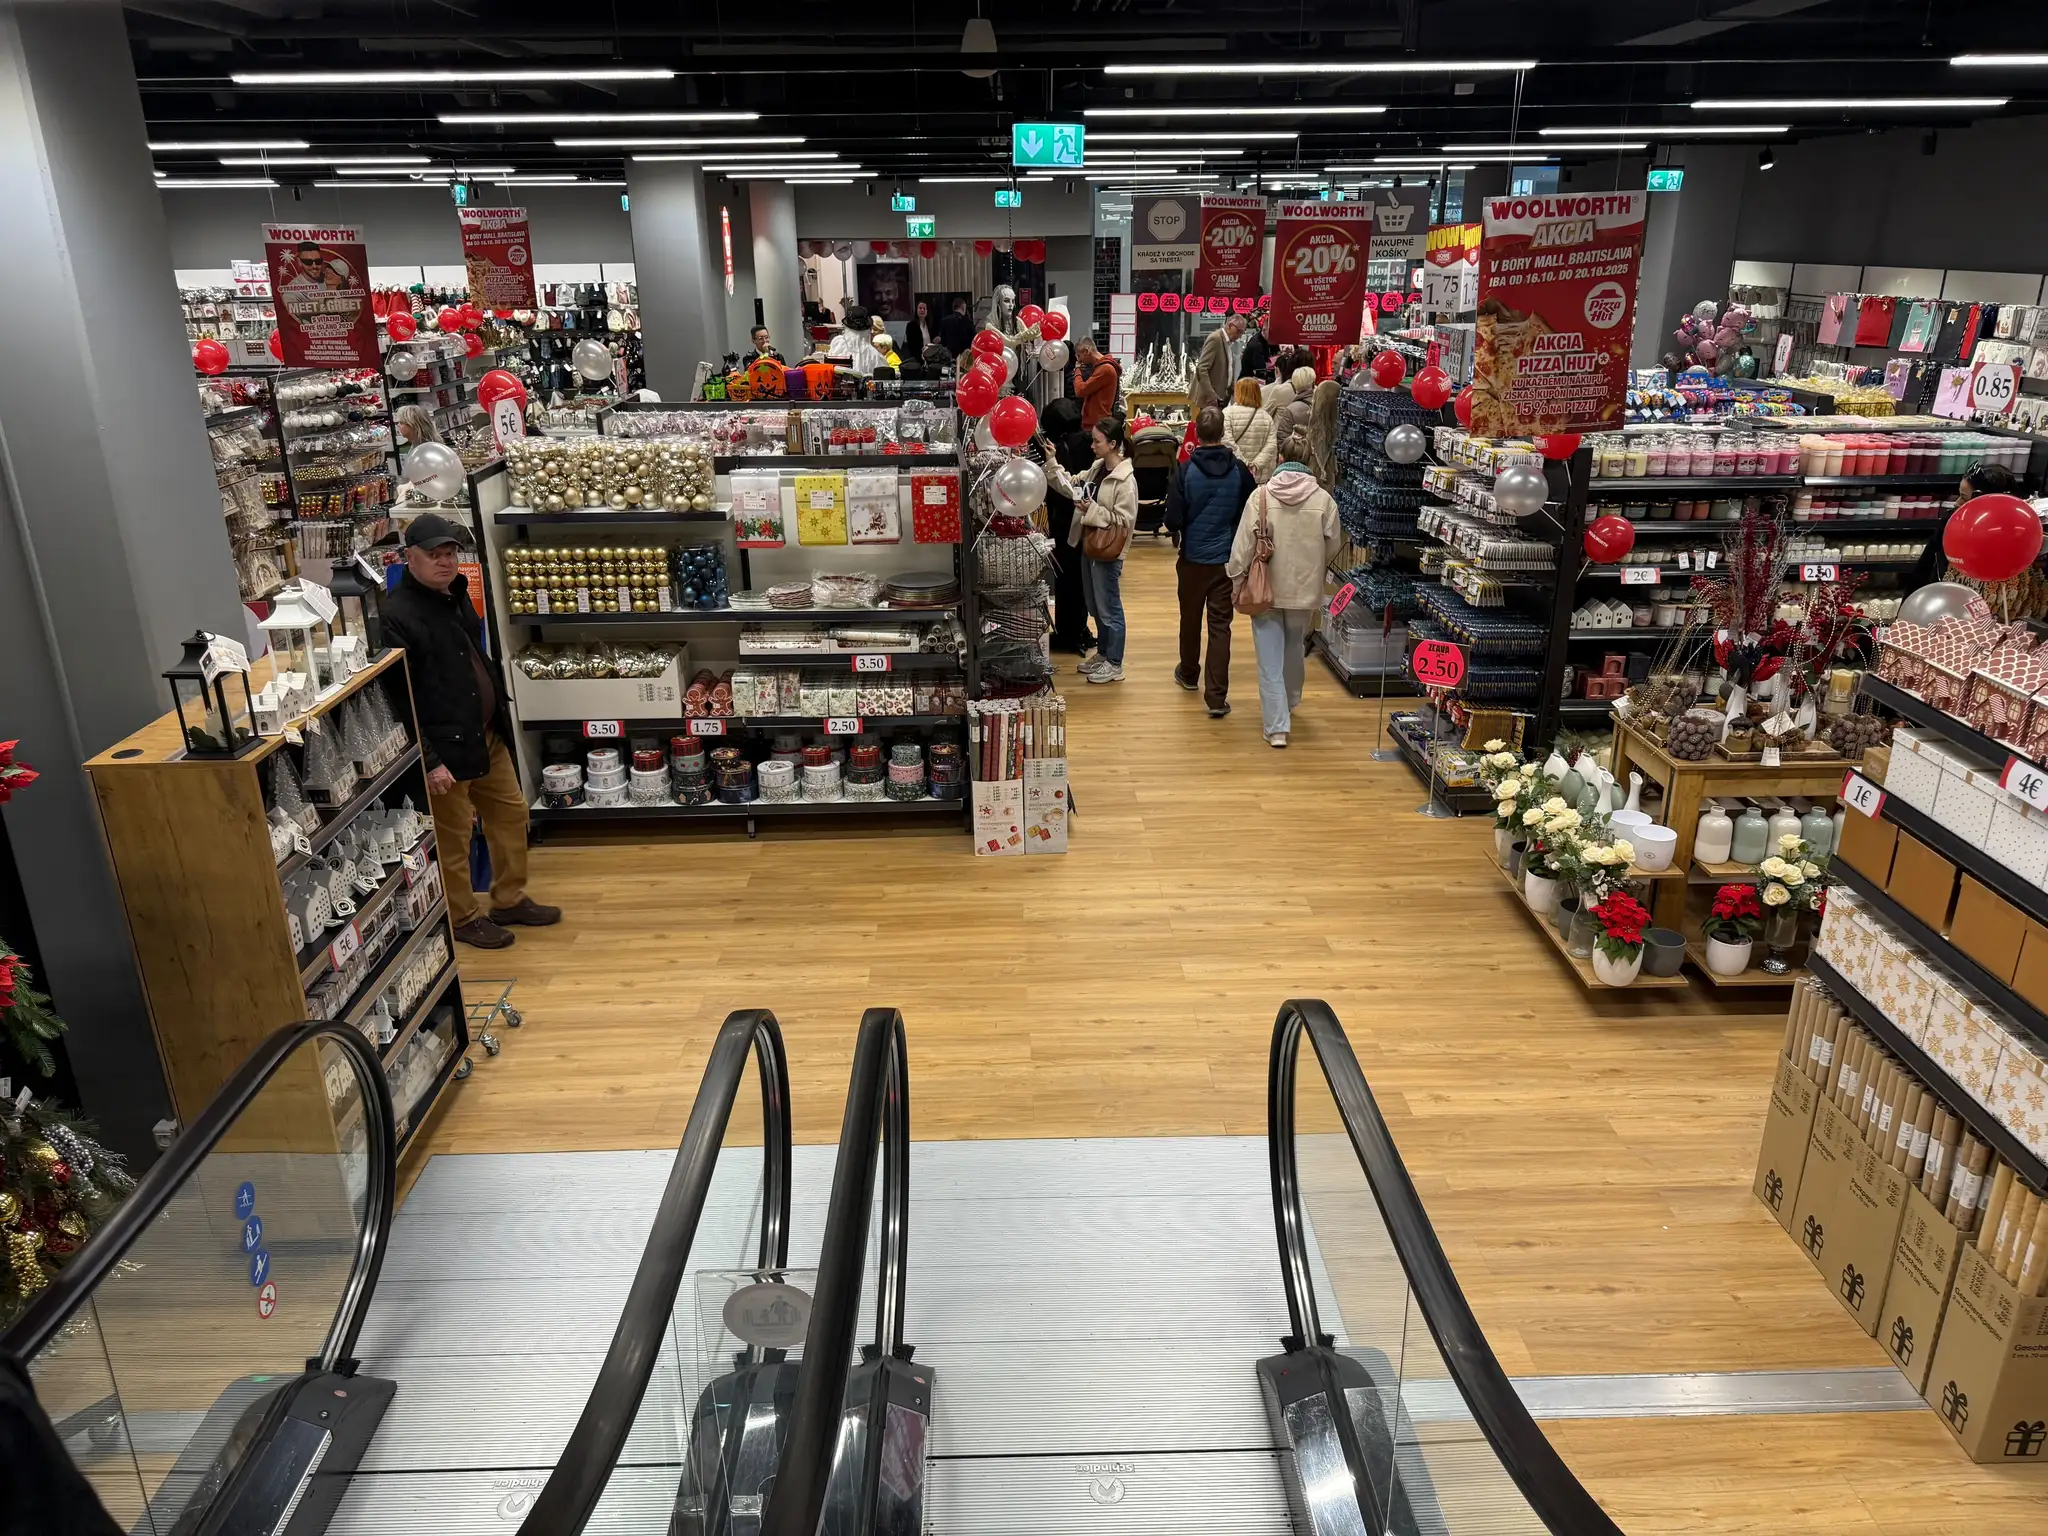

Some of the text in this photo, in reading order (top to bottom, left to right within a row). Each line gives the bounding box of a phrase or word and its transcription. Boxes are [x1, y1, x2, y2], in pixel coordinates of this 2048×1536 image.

[1203, 197, 1260, 207] WOOLWORTH
[1492, 196, 1631, 220] WOOLWORTH
[461, 209, 520, 218] WOOLWORTH
[1283, 206, 1364, 217] WOOLWORTH
[480, 220, 507, 230] AKCIA
[1153, 215, 1180, 226] STOP
[268, 229, 356, 241] WOOLWORTH
[1310, 235, 1335, 244] AKCIA
[1531, 219, 1595, 248] AKCIA
[1372, 237, 1414, 247] NÁKUPNÉ
[1375, 248, 1409, 258] KOŠÍKY
[1490, 246, 1632, 272] V BORY MALL BRATISLAVA
[1217, 275, 1239, 283] AHOJ
[1489, 264, 1628, 287] IBA OD 16.10. DO 20.10.2025
[287, 302, 318, 313] MEET
[326, 299, 362, 311] GREET
[1588, 300, 1622, 314] Pizza
[1305, 313, 1335, 324] AHOJ
[1590, 310, 1614, 322] Hut
[317, 323, 337, 331] ISLAND
[1535, 335, 1581, 350] AKCIA
[1518, 356, 1596, 373] PIZZA HUT
[1511, 374, 1603, 388] KU KAŽDÉMU NÁKUPU
[1976, 376, 2012, 398] 0.85
[1537, 387, 1566, 399] KUPÓN
[1568, 388, 1579, 398] NA
[1550, 405, 1561, 414] NA
[1565, 401, 1596, 413] PIZZU
[500, 412, 518, 436] 5€
[1634, 571, 1648, 581] 2€
[858, 658, 884, 669] 3.50
[1418, 657, 1459, 679] 2.50
[590, 724, 616, 735] 3.50
[694, 722, 719, 733] 1.75
[830, 721, 856, 732] 2.50
[2018, 773, 2044, 800] 4€
[1853, 785, 1872, 808] 1€
[340, 933, 352, 957] 5€
[1075, 1462, 1134, 1474] Schindler
[492, 1477, 547, 1490] chindler
